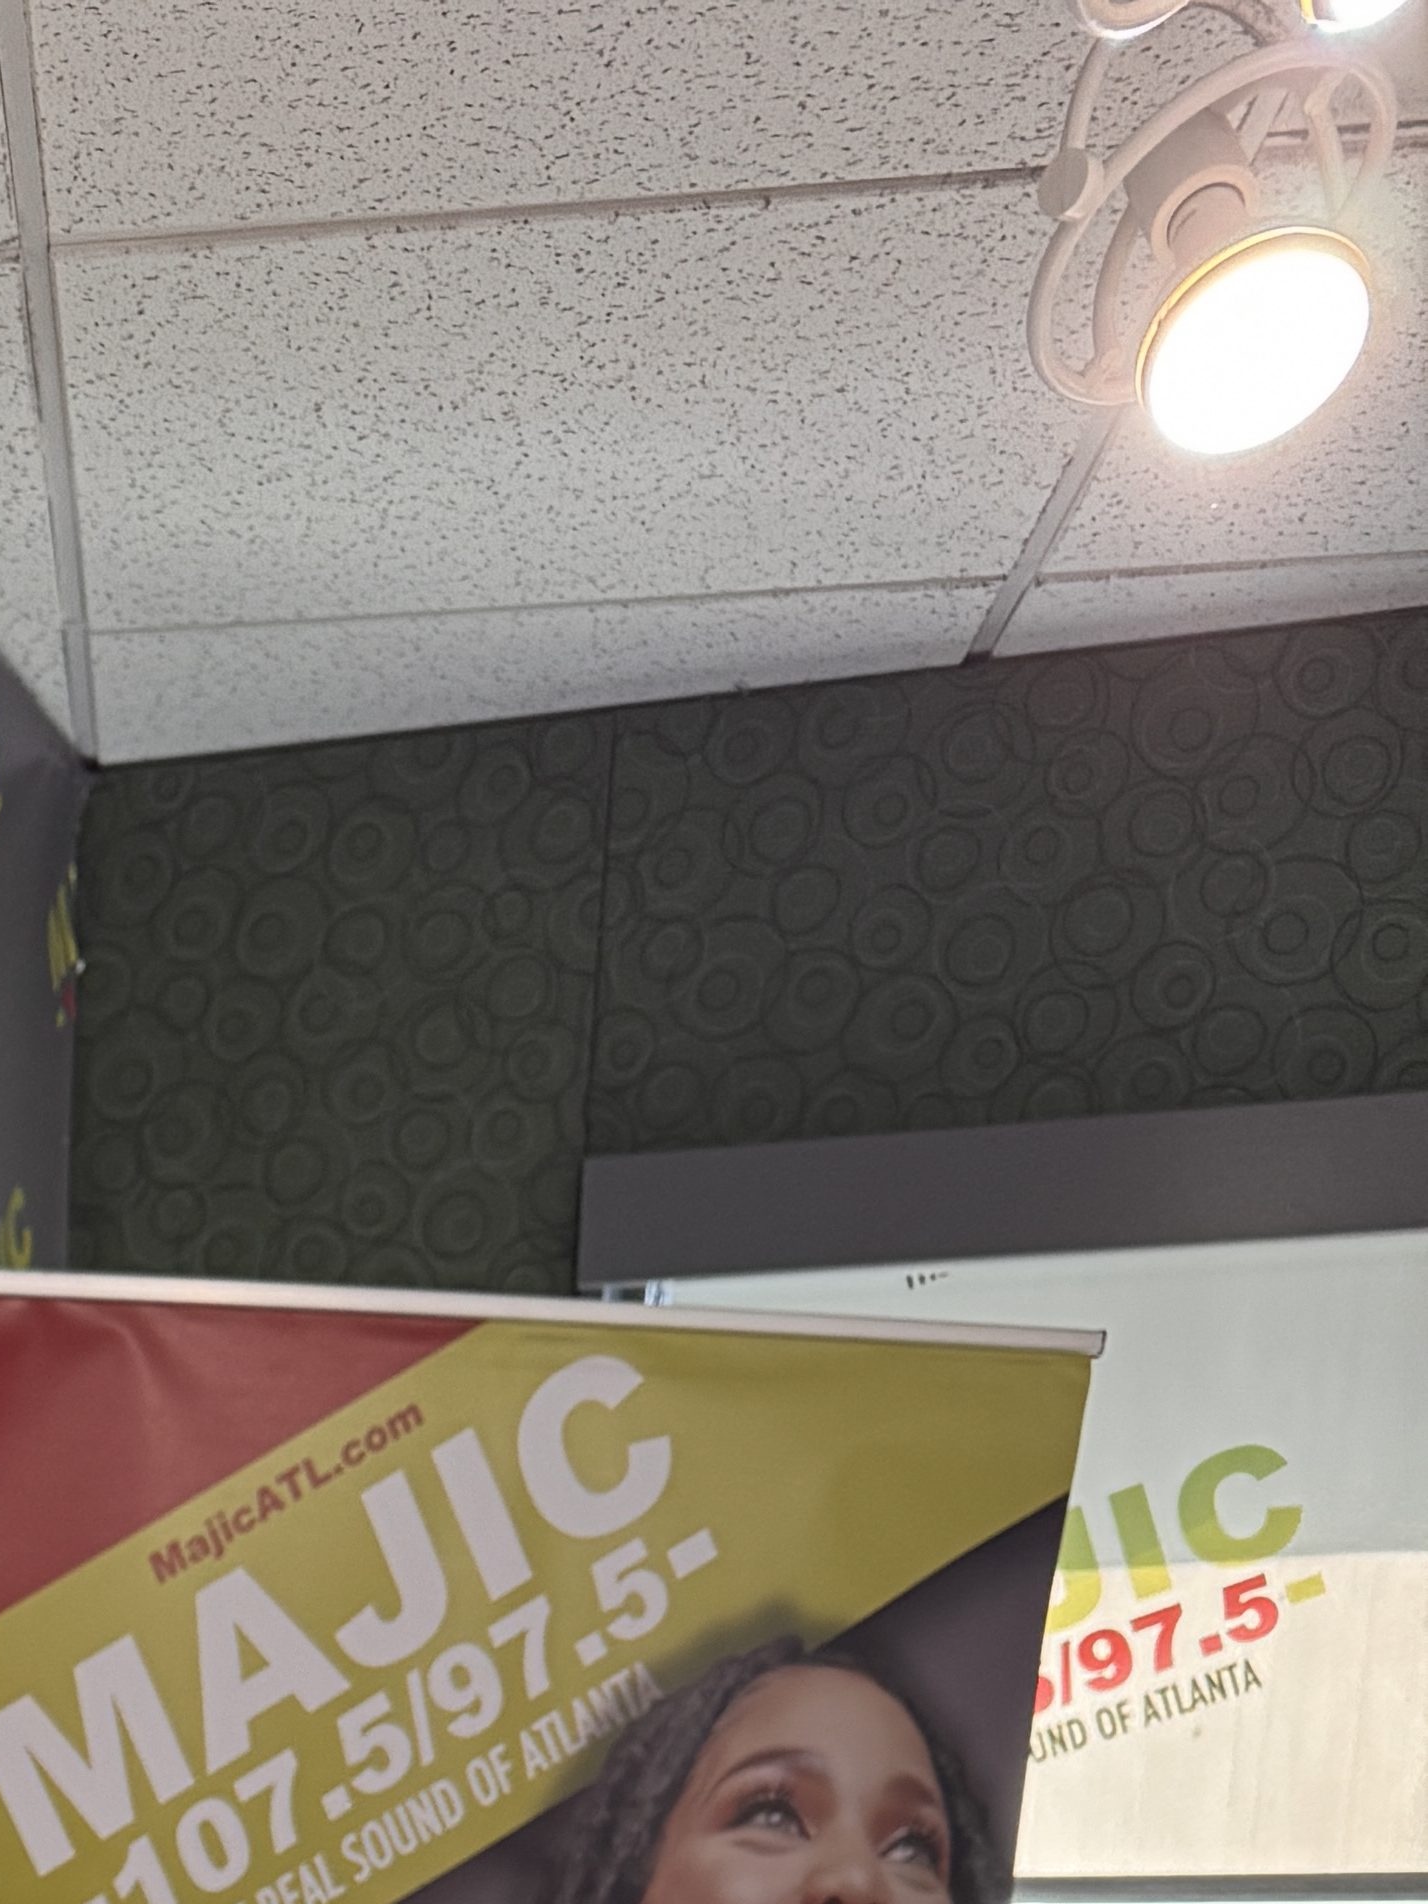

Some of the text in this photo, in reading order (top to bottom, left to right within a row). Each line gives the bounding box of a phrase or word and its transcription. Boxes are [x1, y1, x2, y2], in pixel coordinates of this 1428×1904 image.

[148, 1402, 425, 1585] MajicATL.com
[340, 1775, 466, 1885] SOUND
[465, 1743, 513, 1808] OF
[519, 1661, 665, 1781] ATLANTA
[1095, 1699, 1131, 1740] OF
[1143, 1657, 1263, 1727] ATLANTA
